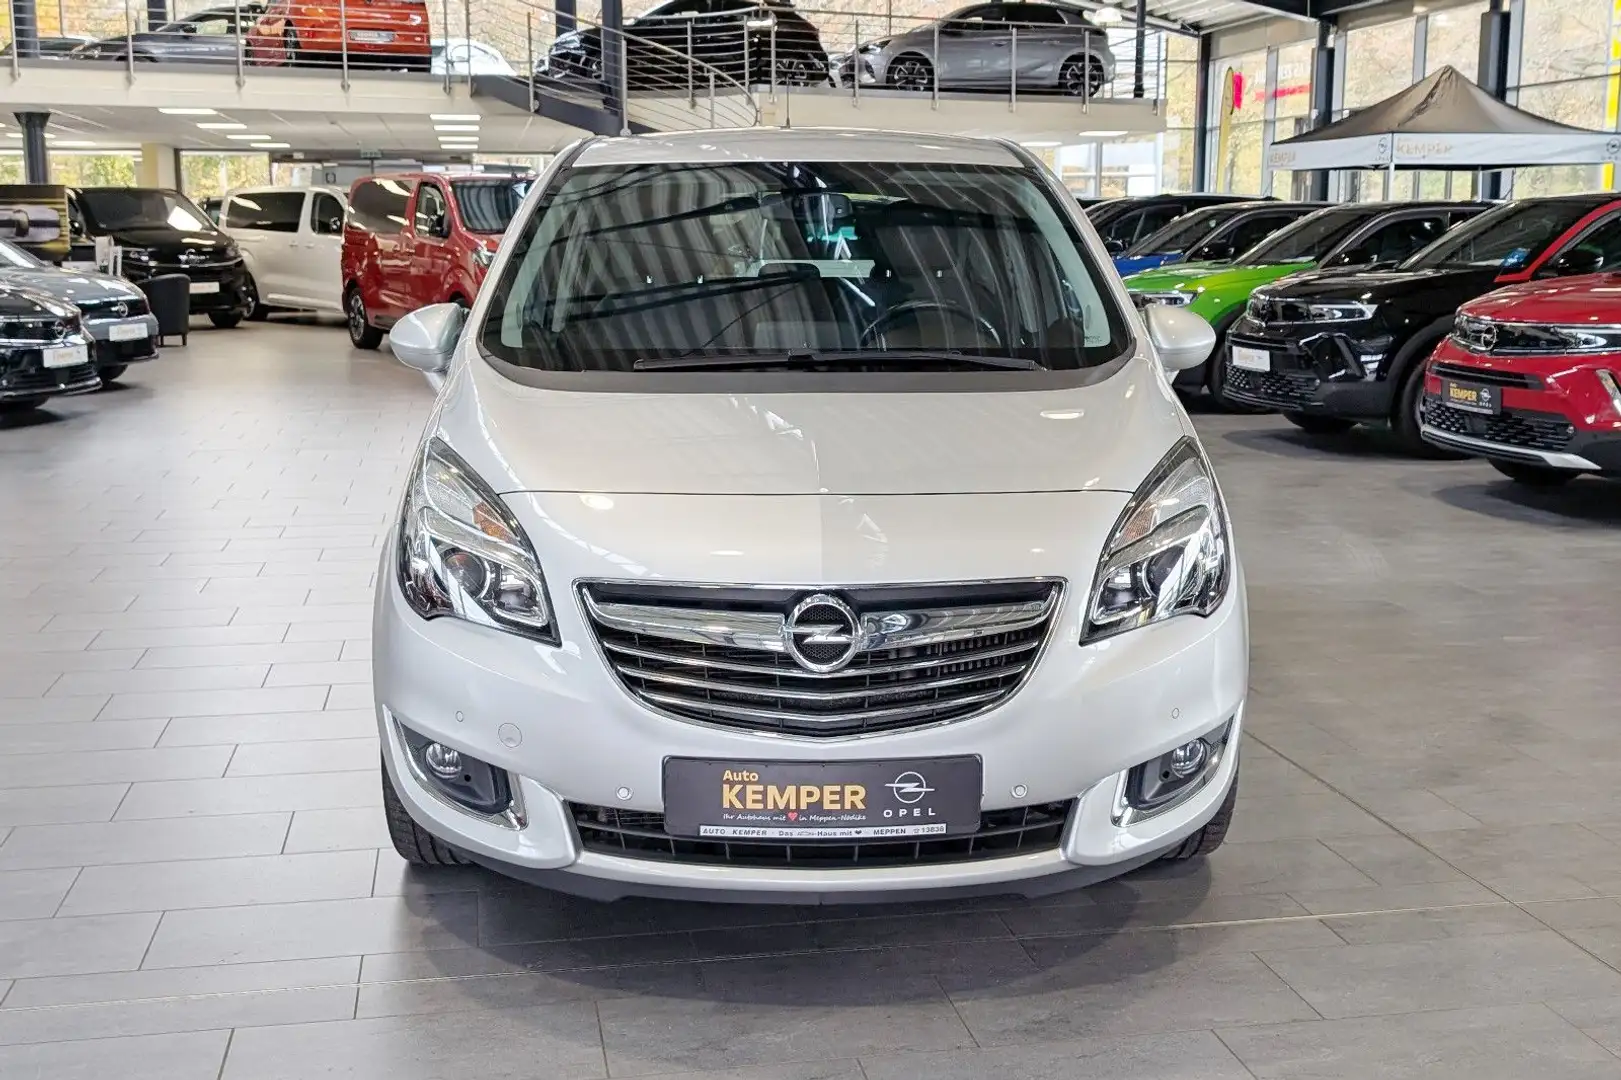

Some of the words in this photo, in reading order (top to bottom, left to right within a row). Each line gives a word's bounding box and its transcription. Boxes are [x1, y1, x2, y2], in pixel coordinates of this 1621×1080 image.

[722, 769, 759, 782] Auto
[722, 783, 867, 810] KEMPER
[736, 813, 771, 821] Autohaus
[883, 807, 936, 818] OPEL
[703, 827, 726, 835] AUTO
[732, 828, 768, 836] KEMPER
[873, 828, 906, 836] MEPPEN
